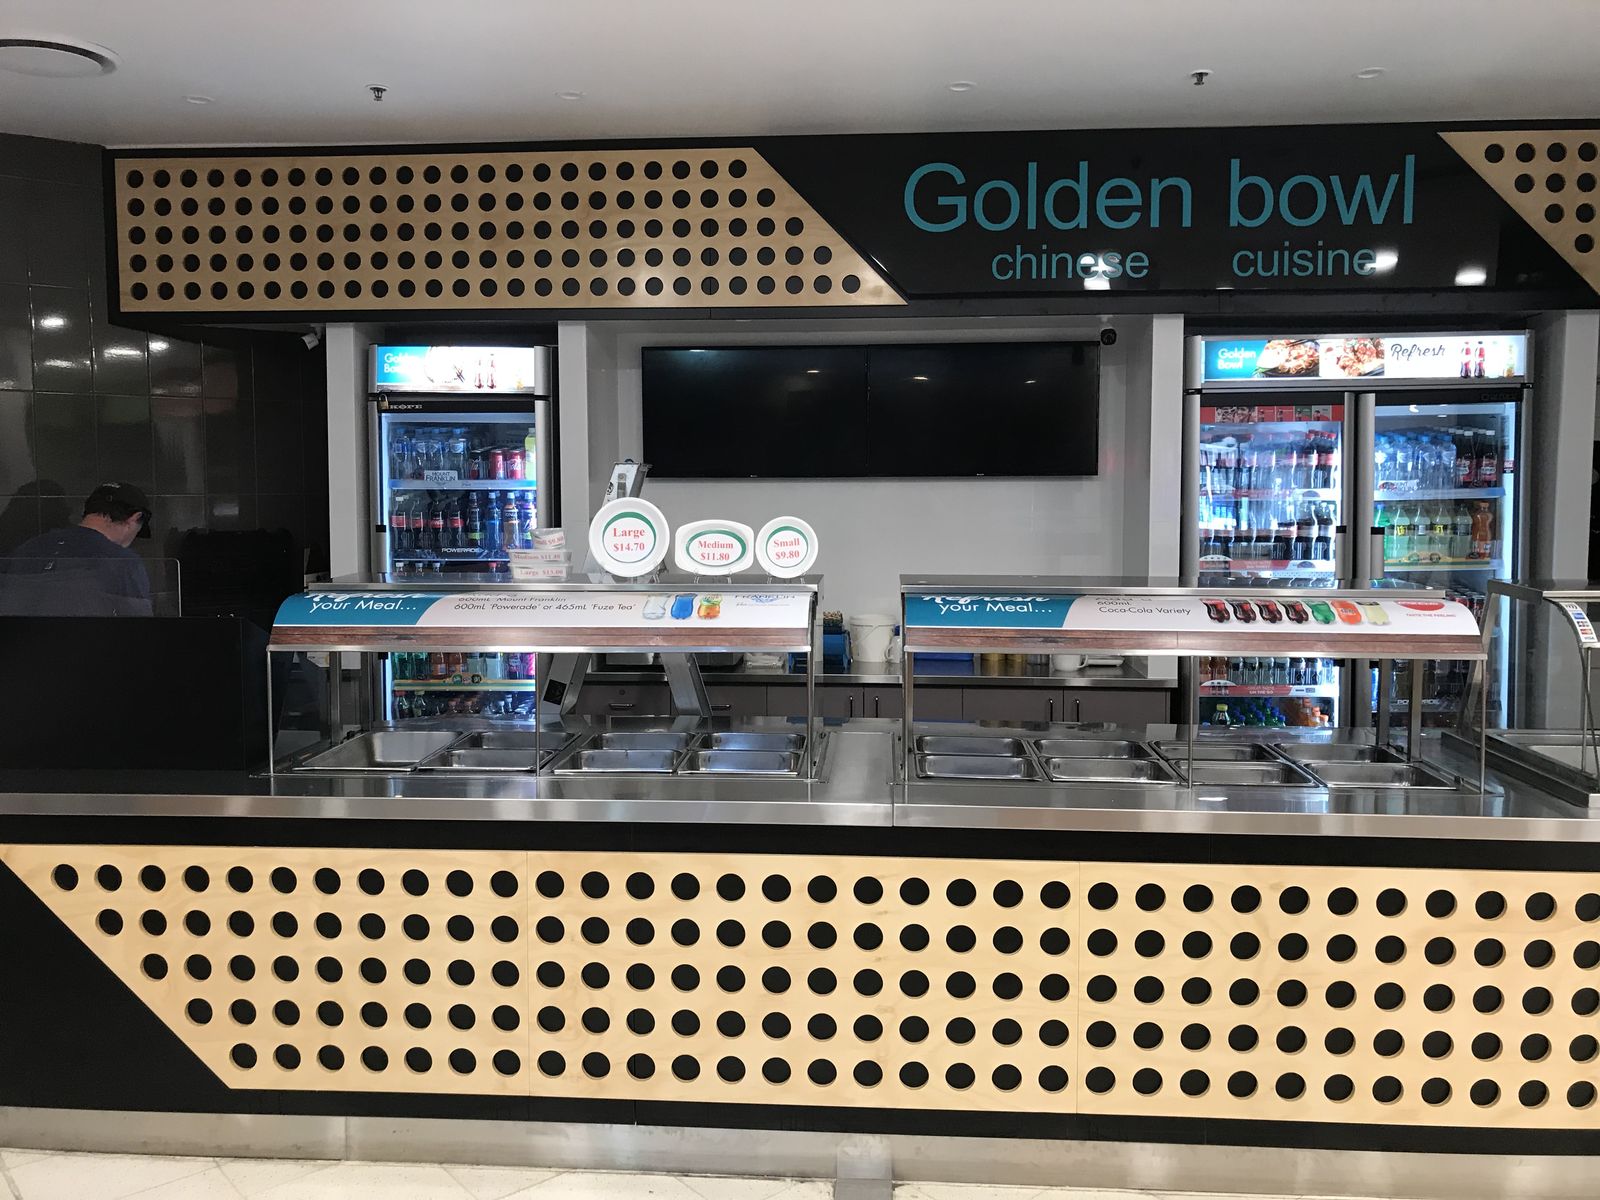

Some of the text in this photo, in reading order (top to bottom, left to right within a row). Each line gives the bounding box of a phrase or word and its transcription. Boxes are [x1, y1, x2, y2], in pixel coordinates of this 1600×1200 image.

[904, 154, 1415, 232] Golden bowl
[991, 240, 1377, 280] chinese cuisine
[1218, 347, 1256, 359] Golden
[1391, 343, 1446, 361] Refresh
[1217, 359, 1243, 370] Bowl
[613, 527, 645, 540] Large
[613, 543, 645, 553] $14.70
[698, 540, 734, 550] Medium
[773, 537, 801, 548] Small
[700, 552, 730, 562] $11.80
[775, 550, 800, 560] $9.80
[309, 599, 417, 613] your Meal...
[939, 602, 1052, 615] your Meal...
[1156, 607, 1191, 615] Variety
